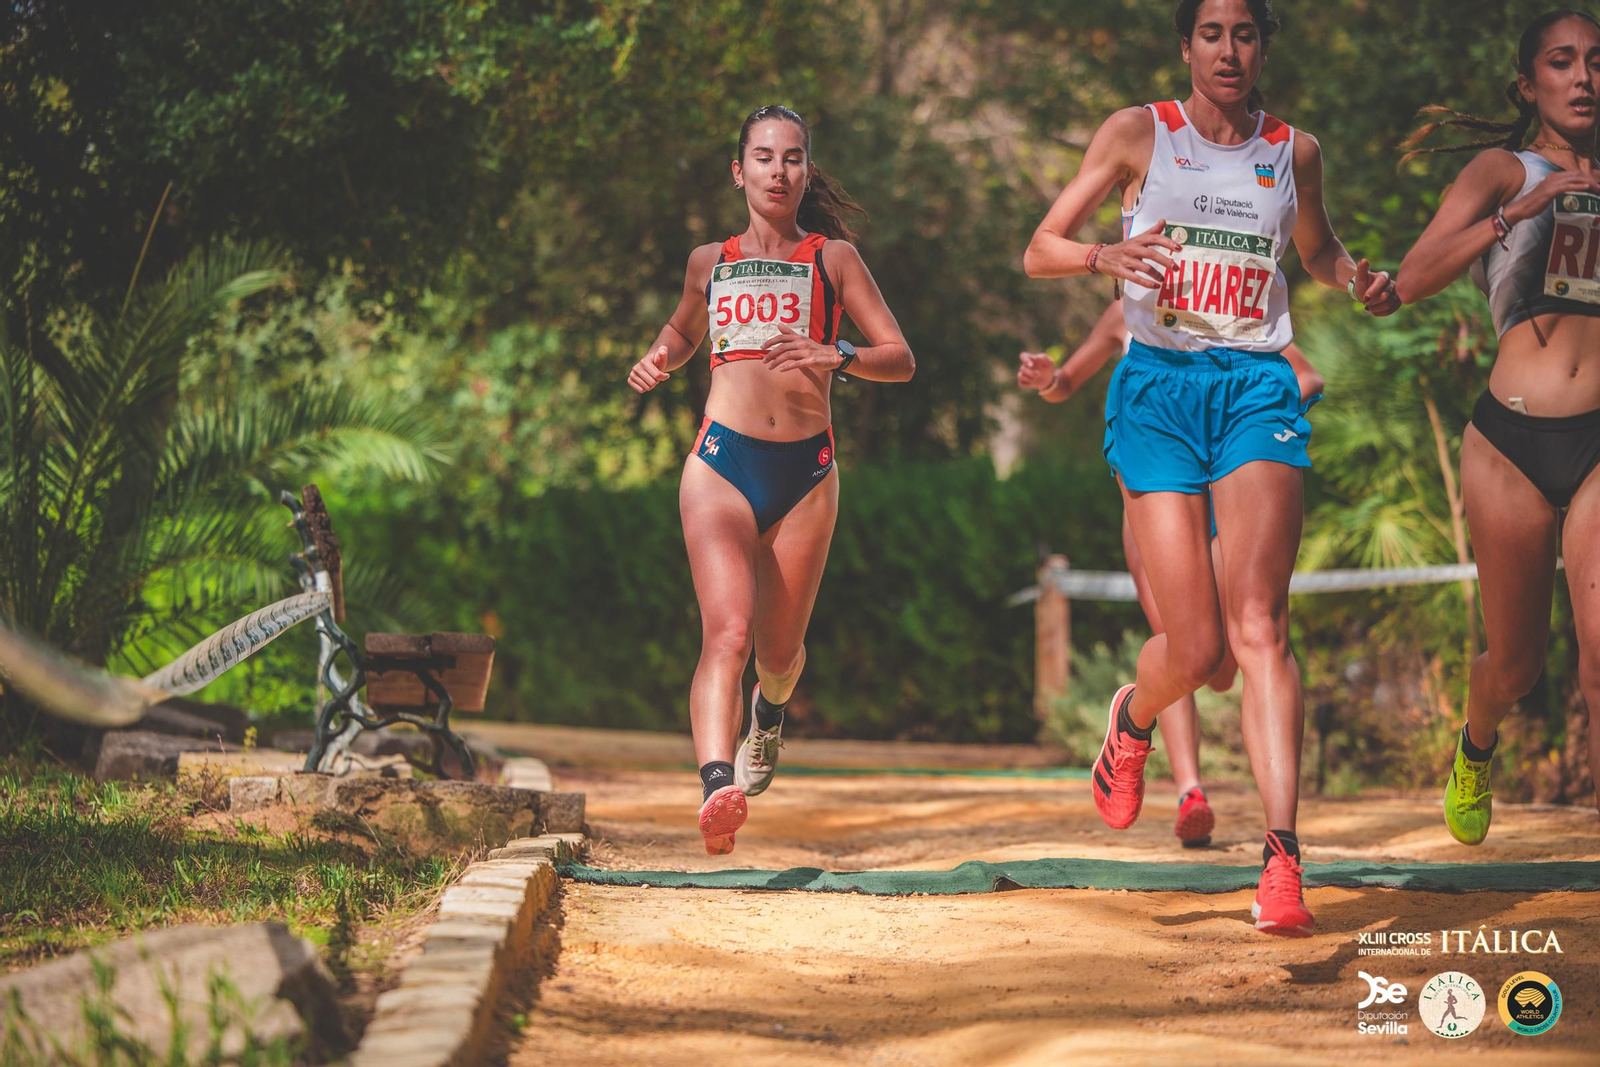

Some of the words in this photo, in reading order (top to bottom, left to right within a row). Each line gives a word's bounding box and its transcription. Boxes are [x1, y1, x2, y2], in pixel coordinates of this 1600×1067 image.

[1216, 197, 1253, 209] Diputació
[1227, 209, 1258, 220] València
[1195, 230, 1250, 249] ITÁLICA
[736, 261, 782, 274] ITÁLICA
[716, 293, 801, 326] 5003
